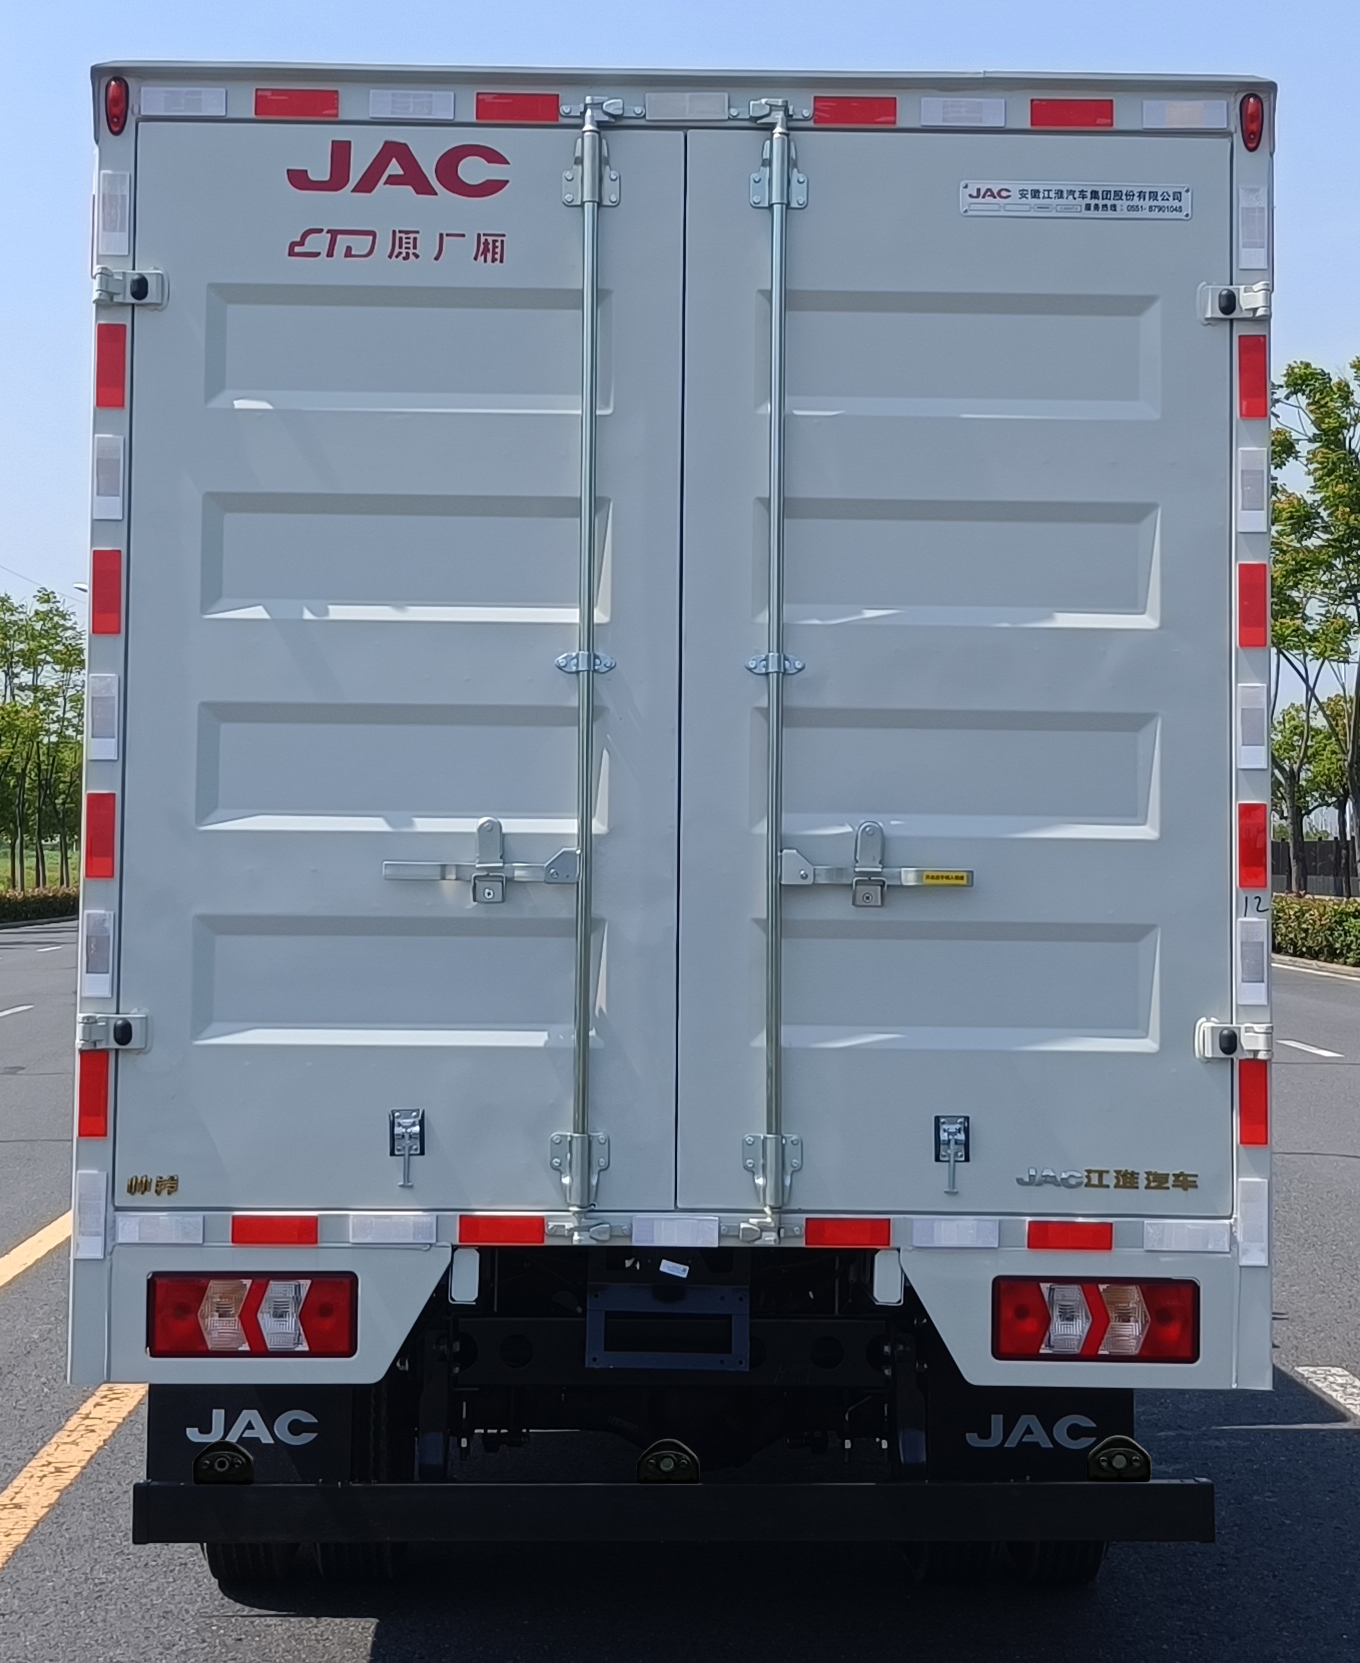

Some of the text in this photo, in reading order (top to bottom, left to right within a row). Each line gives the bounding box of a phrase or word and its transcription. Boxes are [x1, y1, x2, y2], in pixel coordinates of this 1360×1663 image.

[286, 140, 511, 198] JAC
[968, 188, 1183, 203] JAC 安徽江淮汽车集团股份有限公司
[387, 229, 506, 264] 原厂厢
[1244, 896, 1269, 917] 12
[1016, 1167, 1199, 1191] JAC 江淮汽车
[186, 1409, 319, 1445] JAC
[966, 1414, 1098, 1450] JAC
